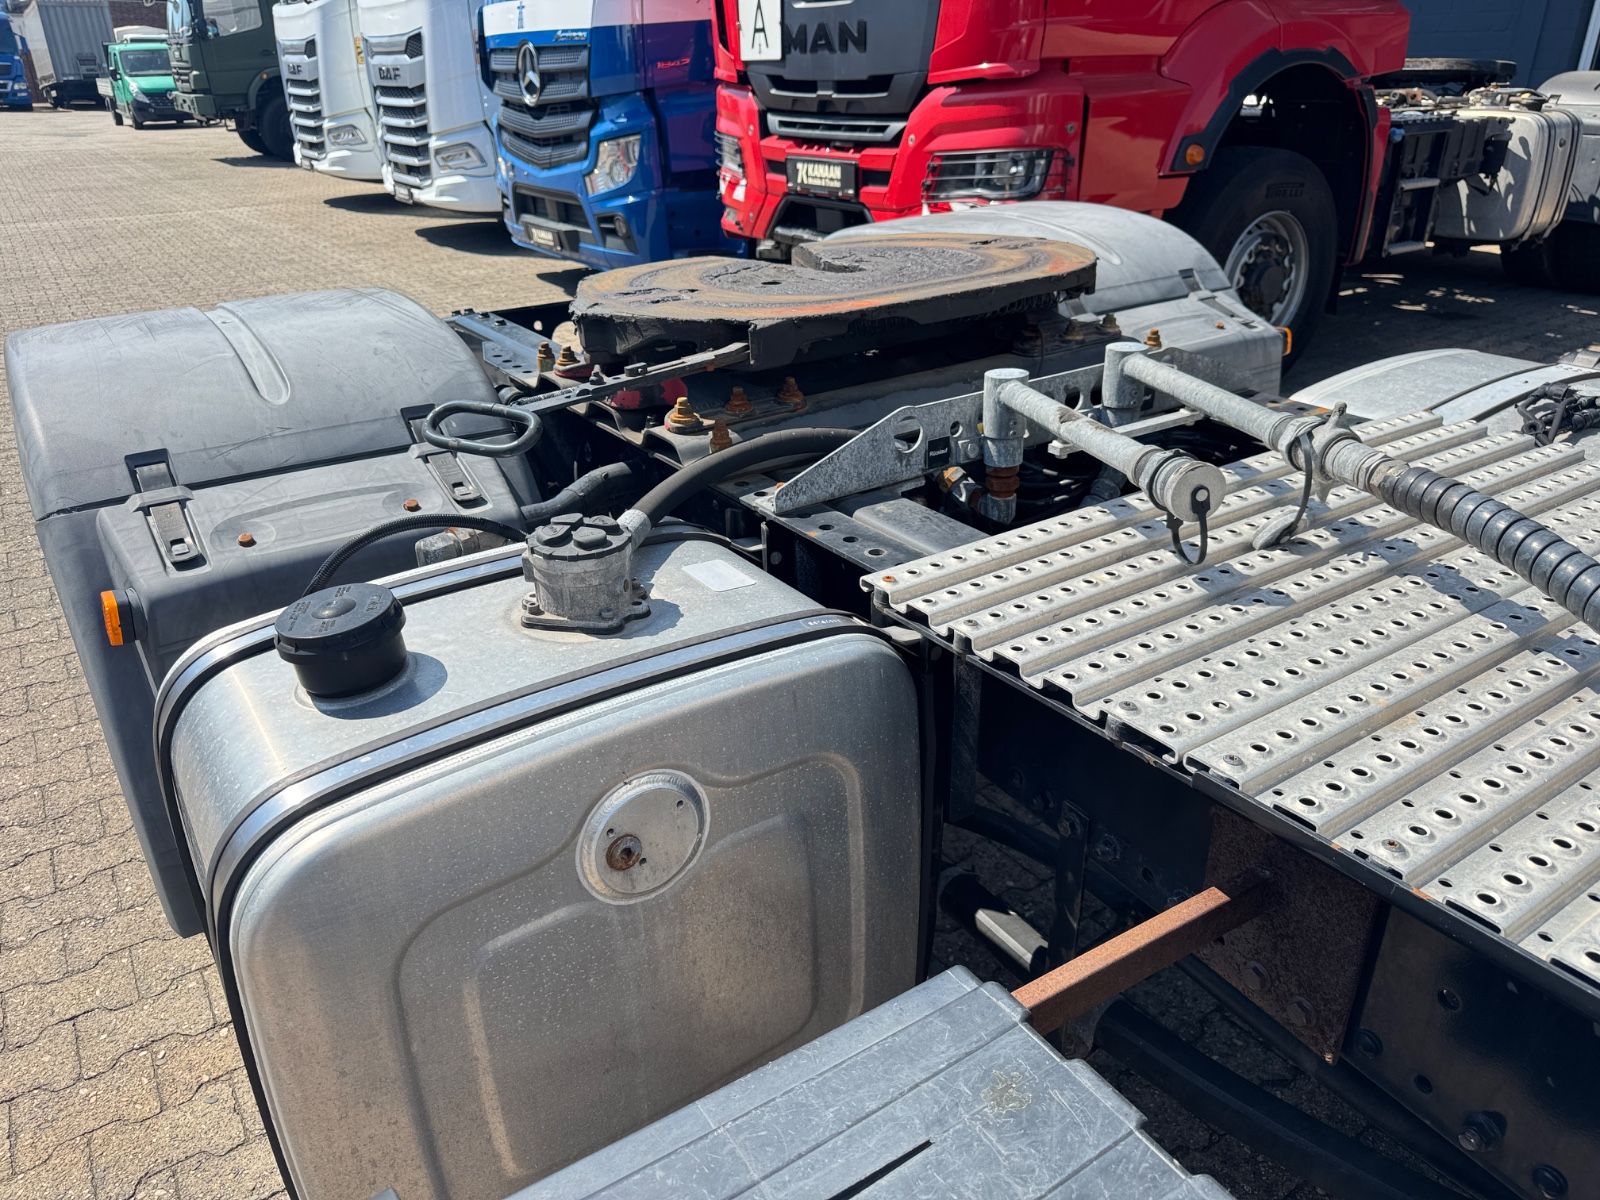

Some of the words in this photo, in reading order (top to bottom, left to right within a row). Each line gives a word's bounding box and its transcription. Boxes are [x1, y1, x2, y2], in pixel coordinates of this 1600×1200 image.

[752, 0, 769, 49] A
[784, 20, 868, 55] MAN
[378, 66, 401, 81] DAF
[807, 162, 842, 180] KANAAN
[1265, 182, 1305, 200] PIRELLI
